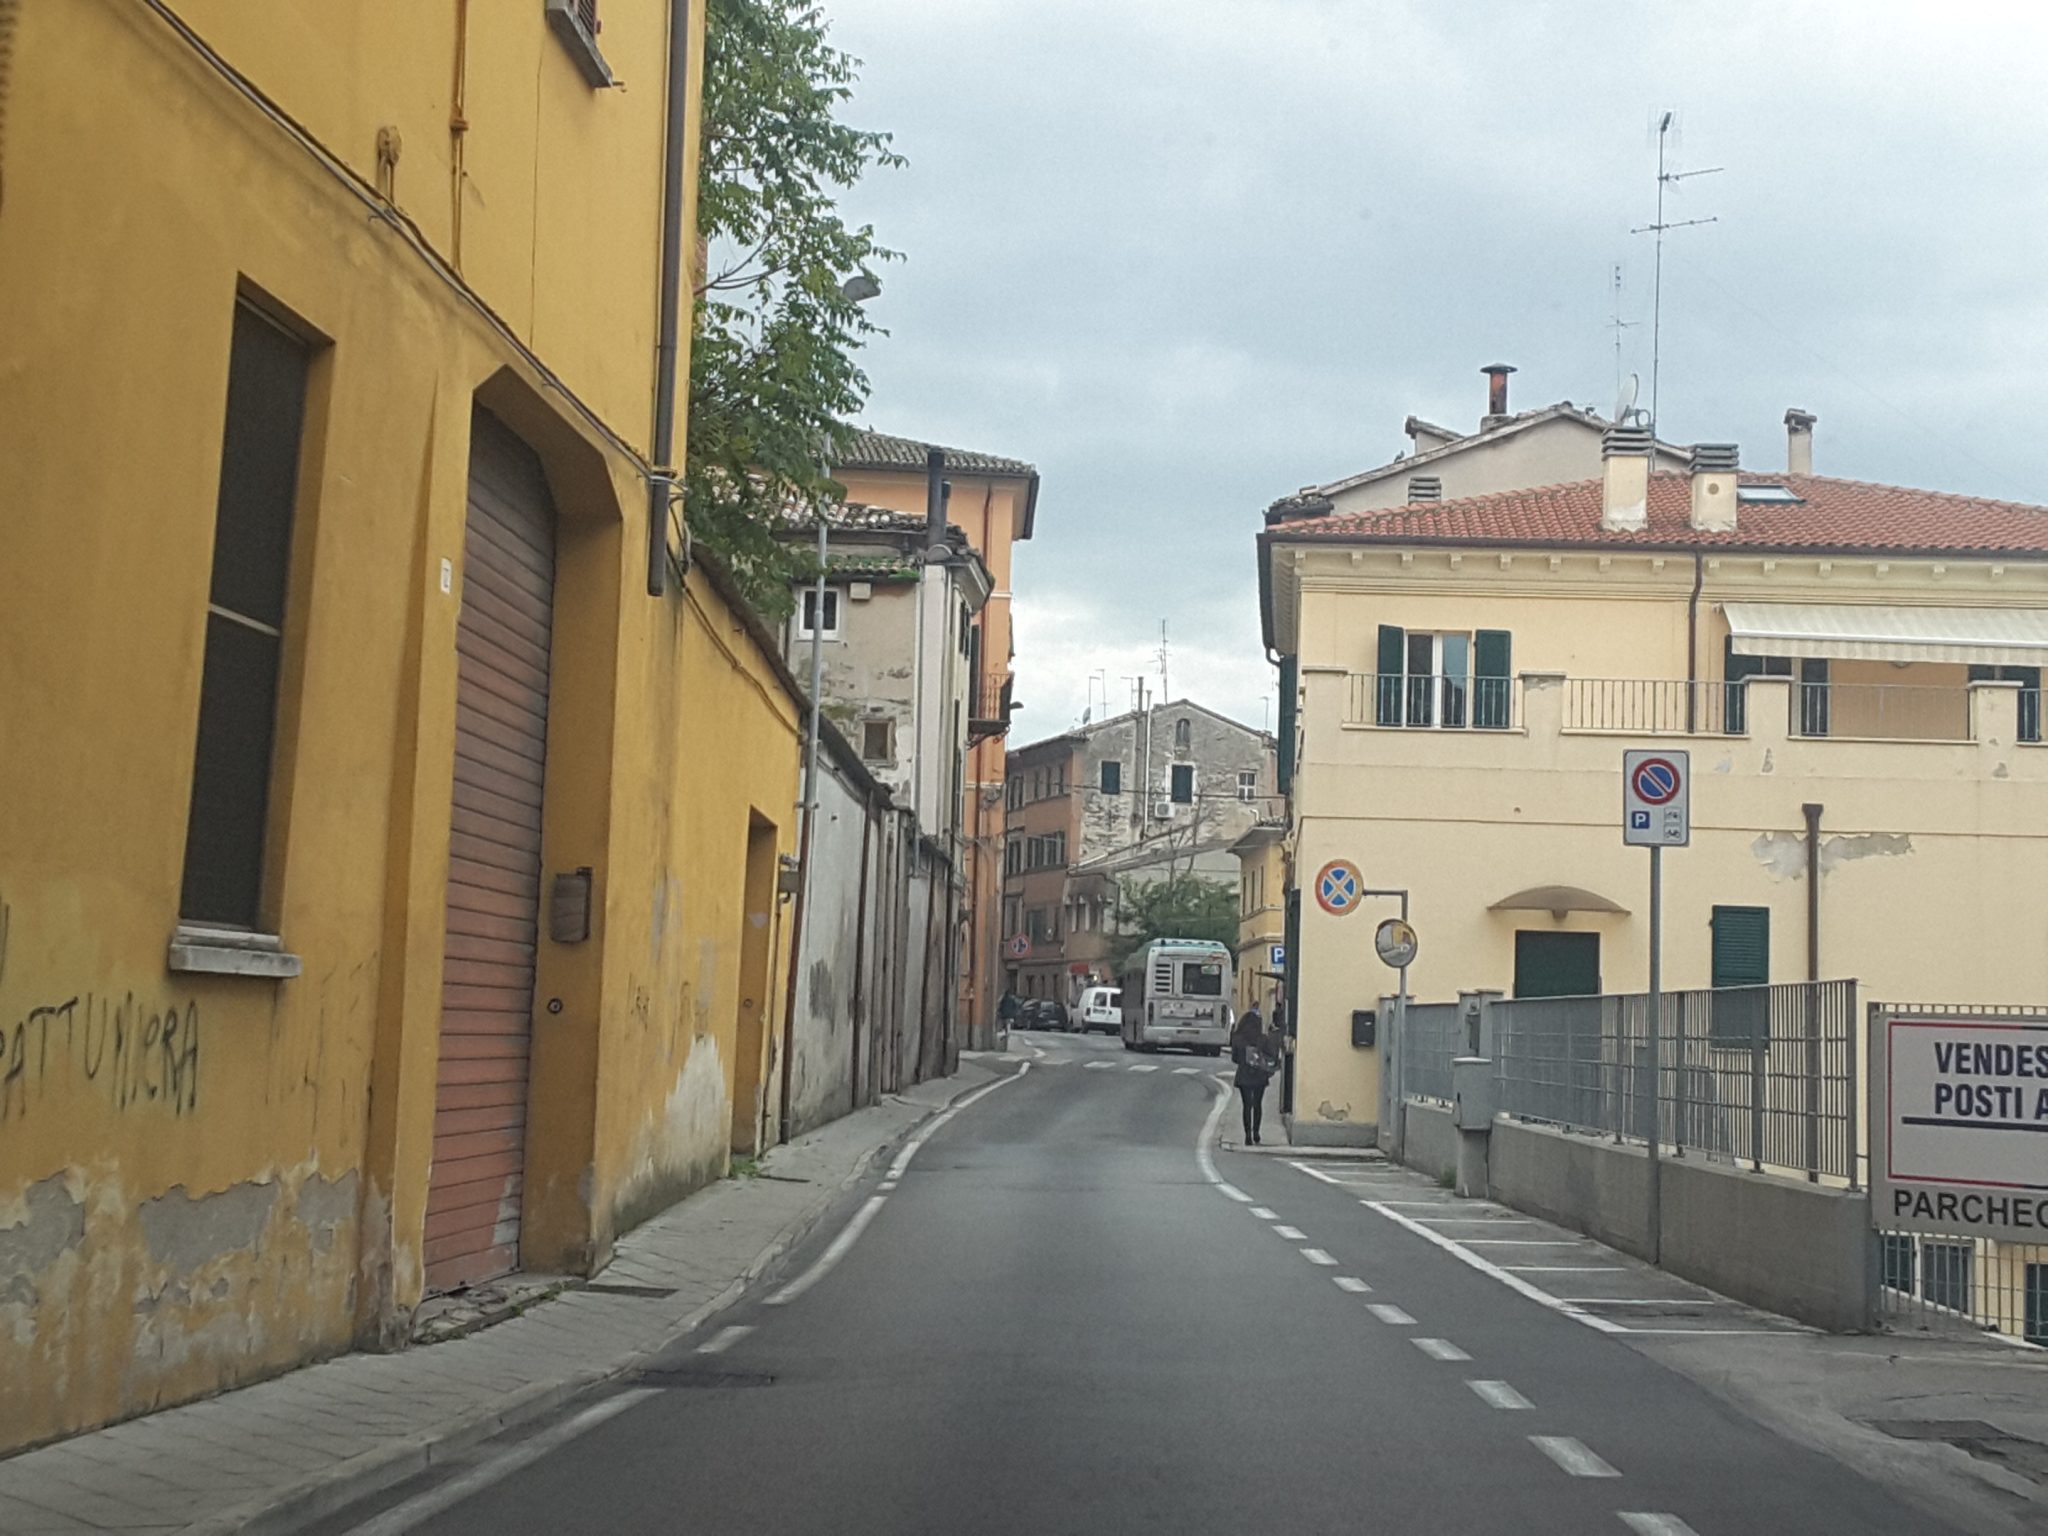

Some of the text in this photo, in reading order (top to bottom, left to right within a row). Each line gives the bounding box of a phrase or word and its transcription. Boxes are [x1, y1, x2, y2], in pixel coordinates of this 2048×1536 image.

[1635, 813, 1647, 827] P
[1274, 947, 1285, 963] P
[1935, 1042, 2048, 1079] VENDES
[1935, 1083, 2022, 1119] POSTI
